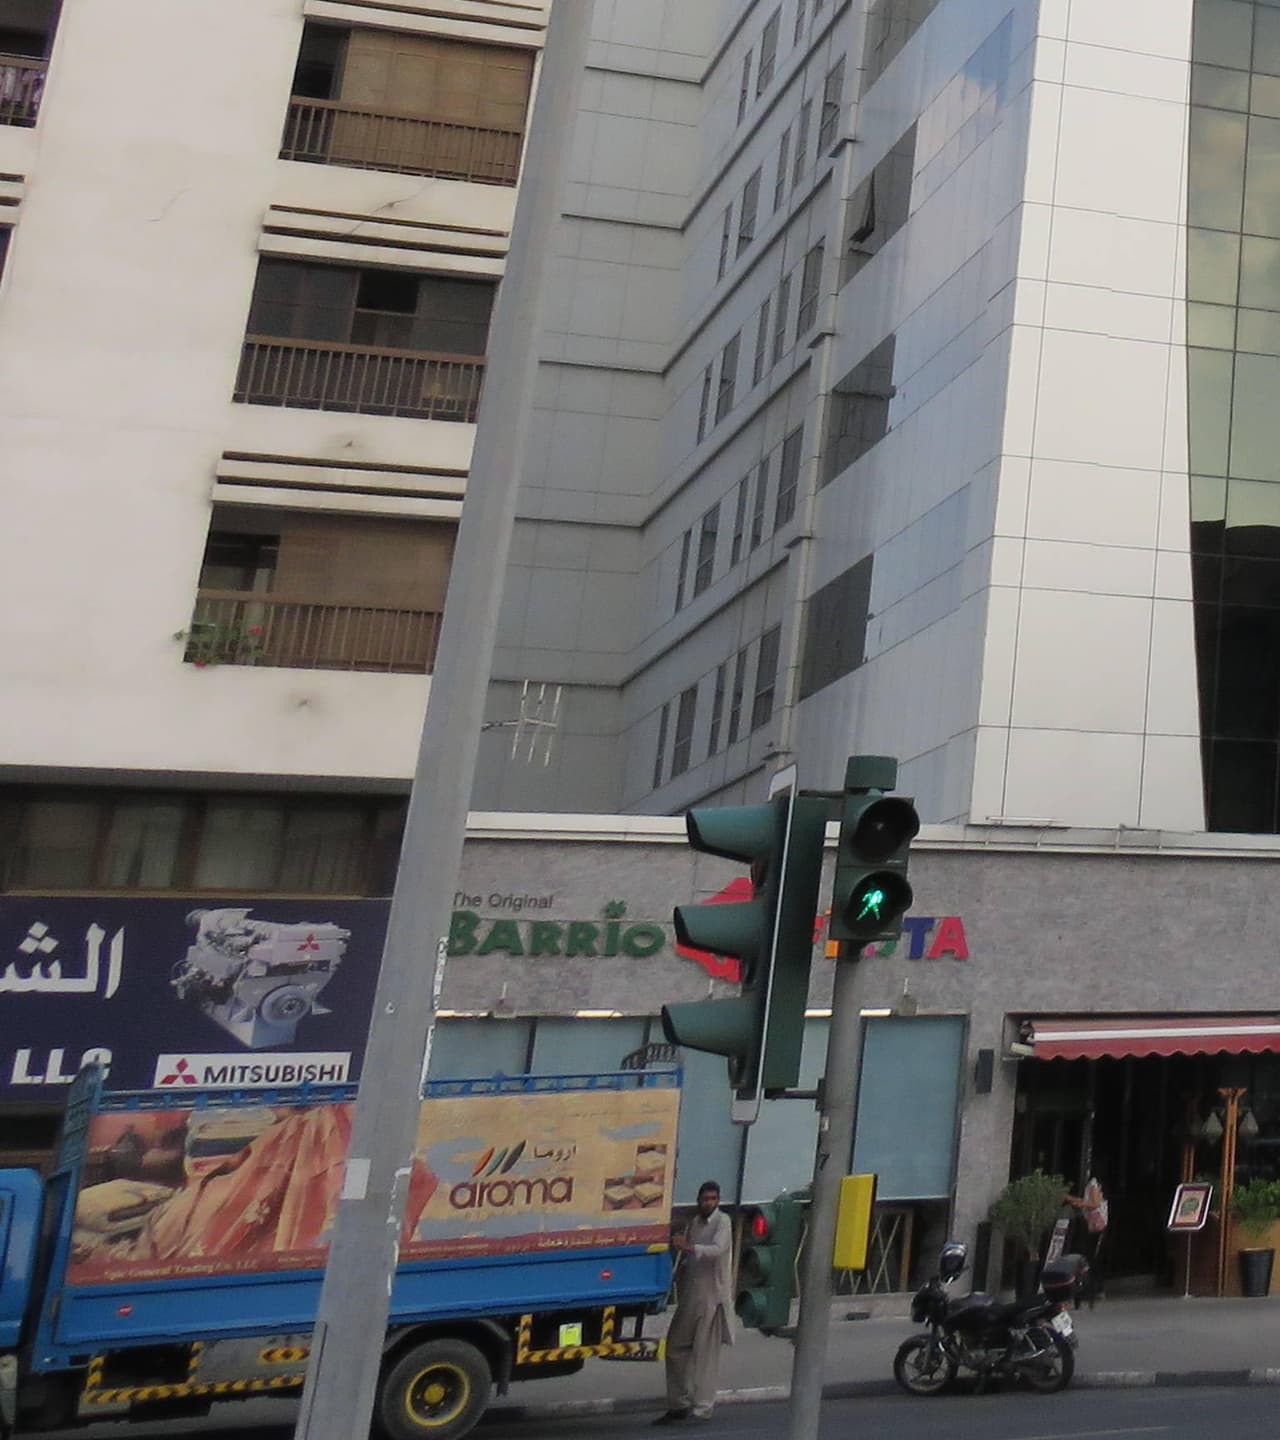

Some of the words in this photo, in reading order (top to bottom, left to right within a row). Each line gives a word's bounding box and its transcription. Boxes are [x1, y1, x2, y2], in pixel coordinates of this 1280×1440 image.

[455, 892, 484, 908] The
[486, 892, 554, 911] Original
[203, 1063, 344, 1085] MITSUBISHI
[450, 1176, 574, 1209] aroma
